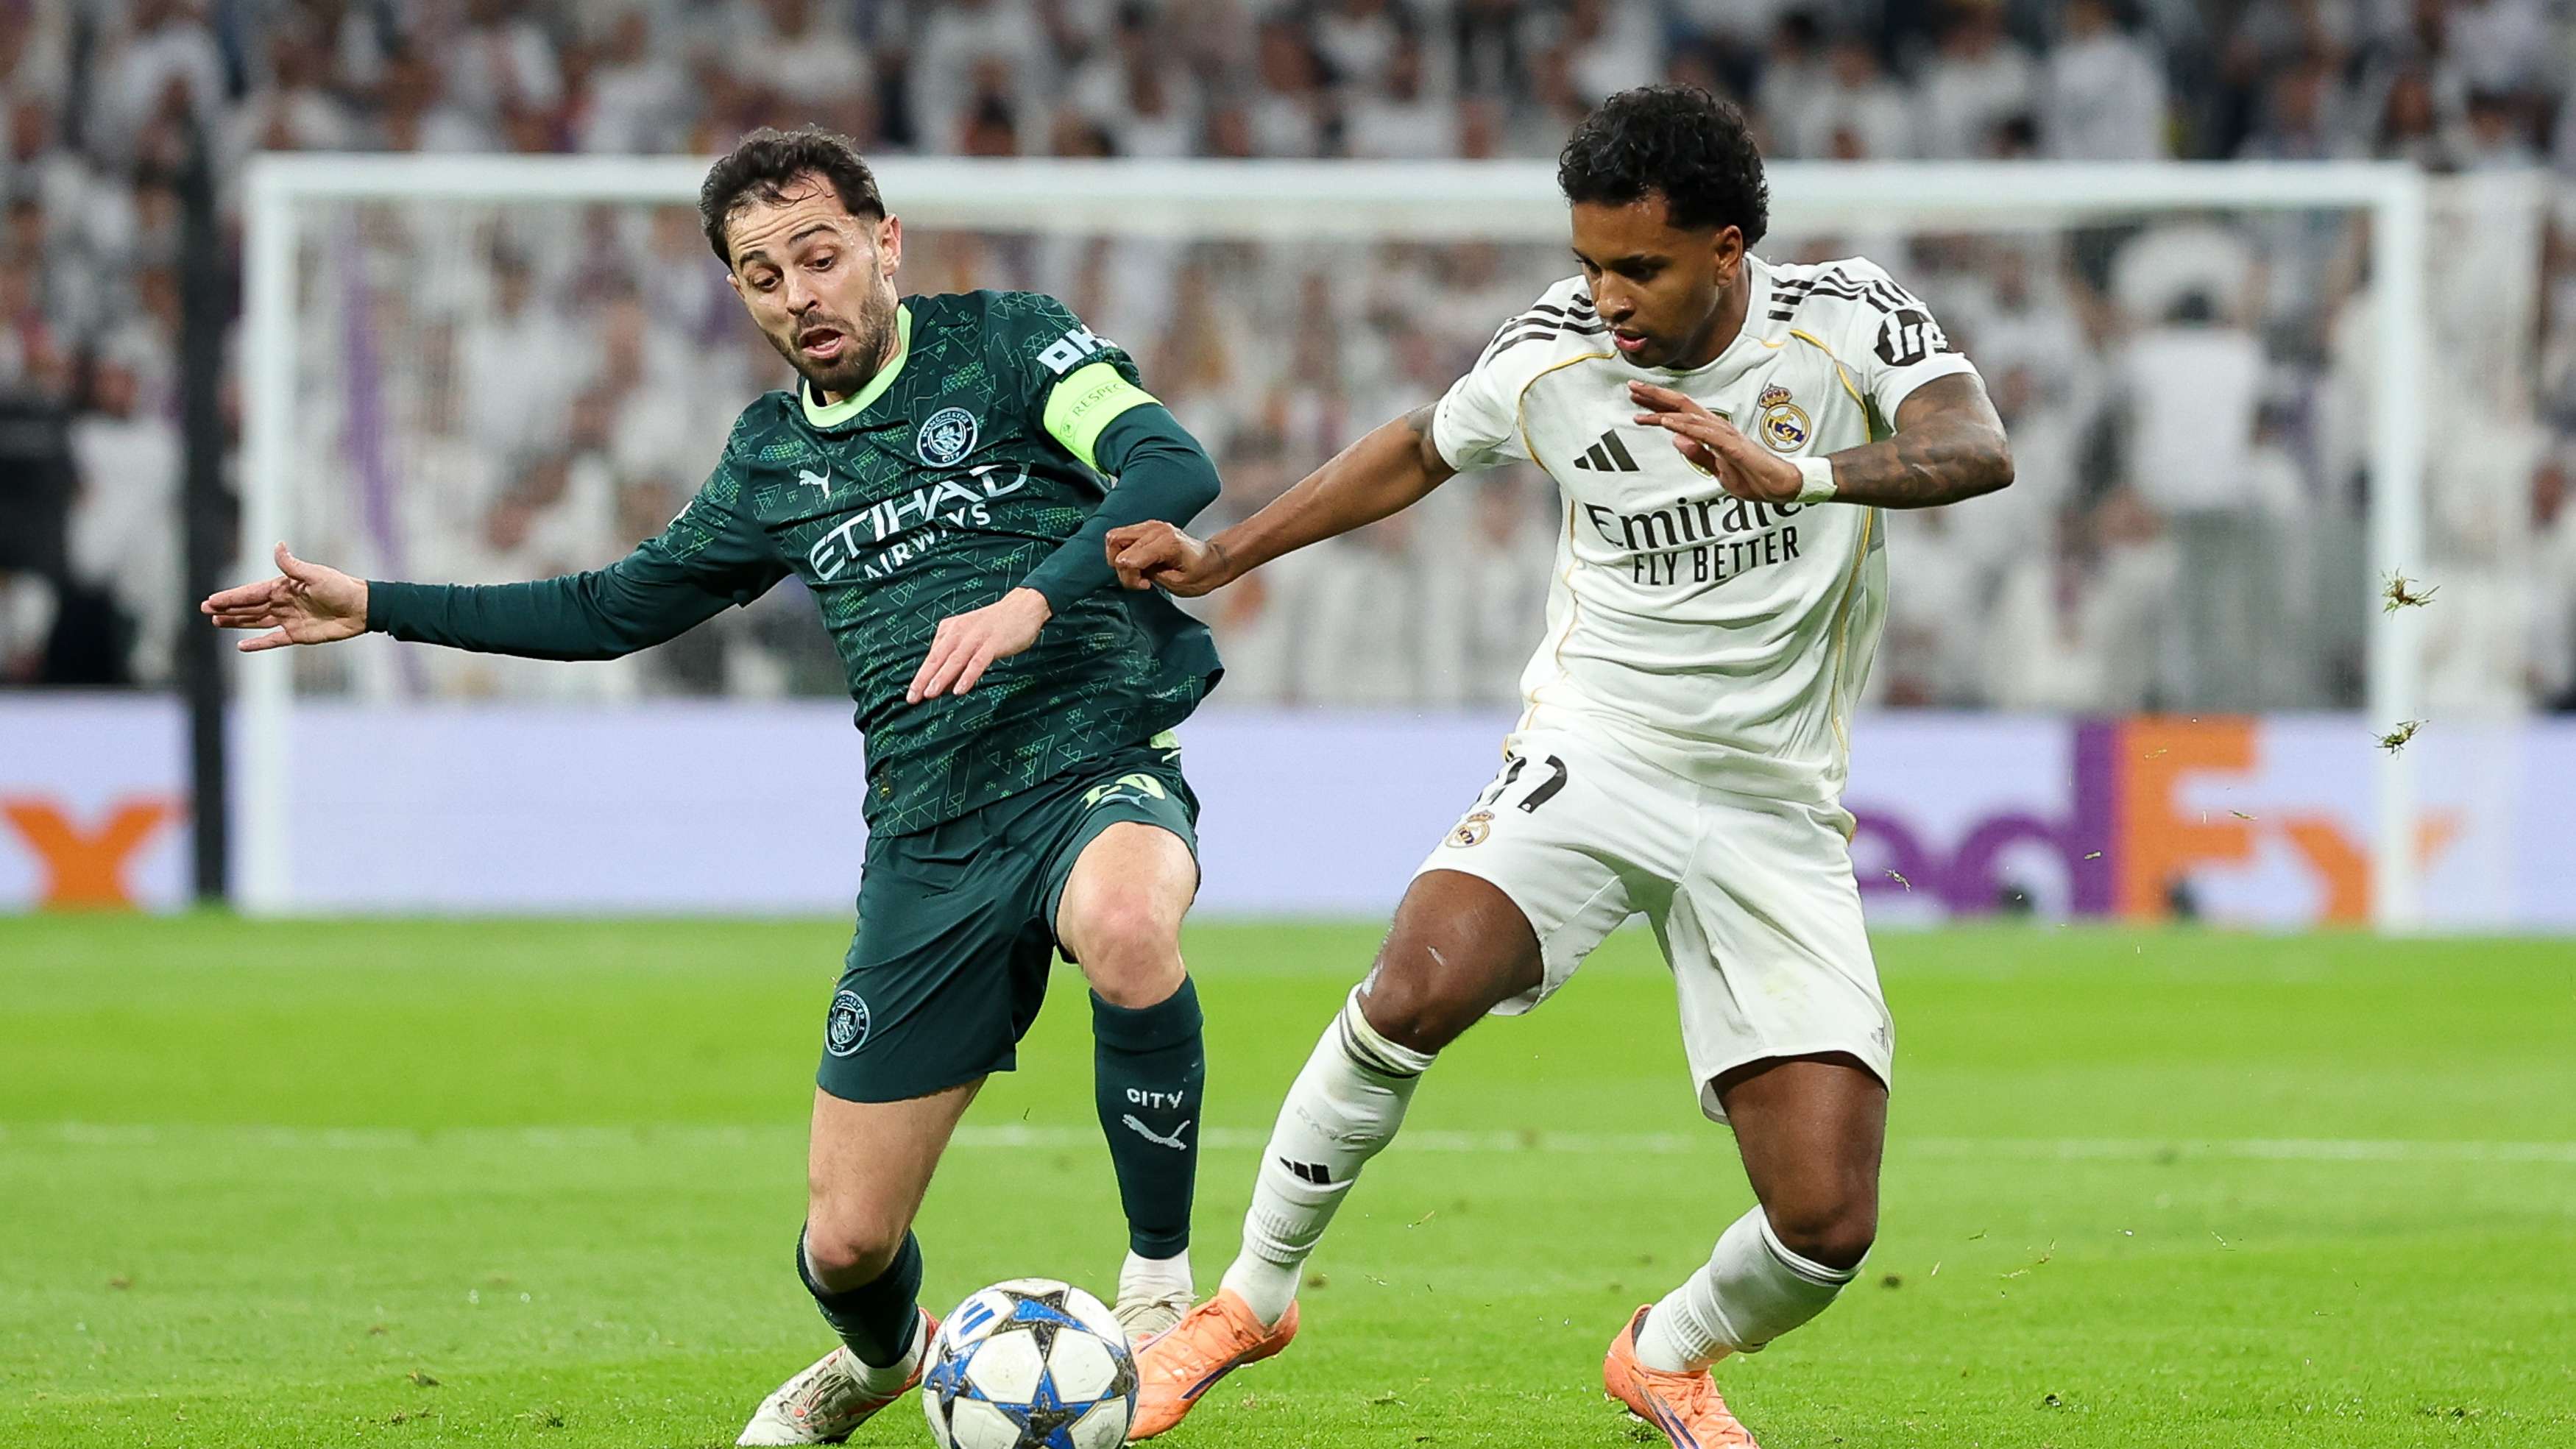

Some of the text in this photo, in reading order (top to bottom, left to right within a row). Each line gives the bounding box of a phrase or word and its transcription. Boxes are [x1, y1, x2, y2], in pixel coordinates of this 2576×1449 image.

[1036, 323, 1118, 375] OK
[1072, 381, 1127, 417] RESPEC
[810, 462, 1029, 581] ETIHAD
[864, 503, 991, 578] AIRWYS
[1584, 493, 1819, 551] Emirat
[1633, 525, 1800, 586] FLY BETTER
[1126, 1088, 1183, 1109] CITY
